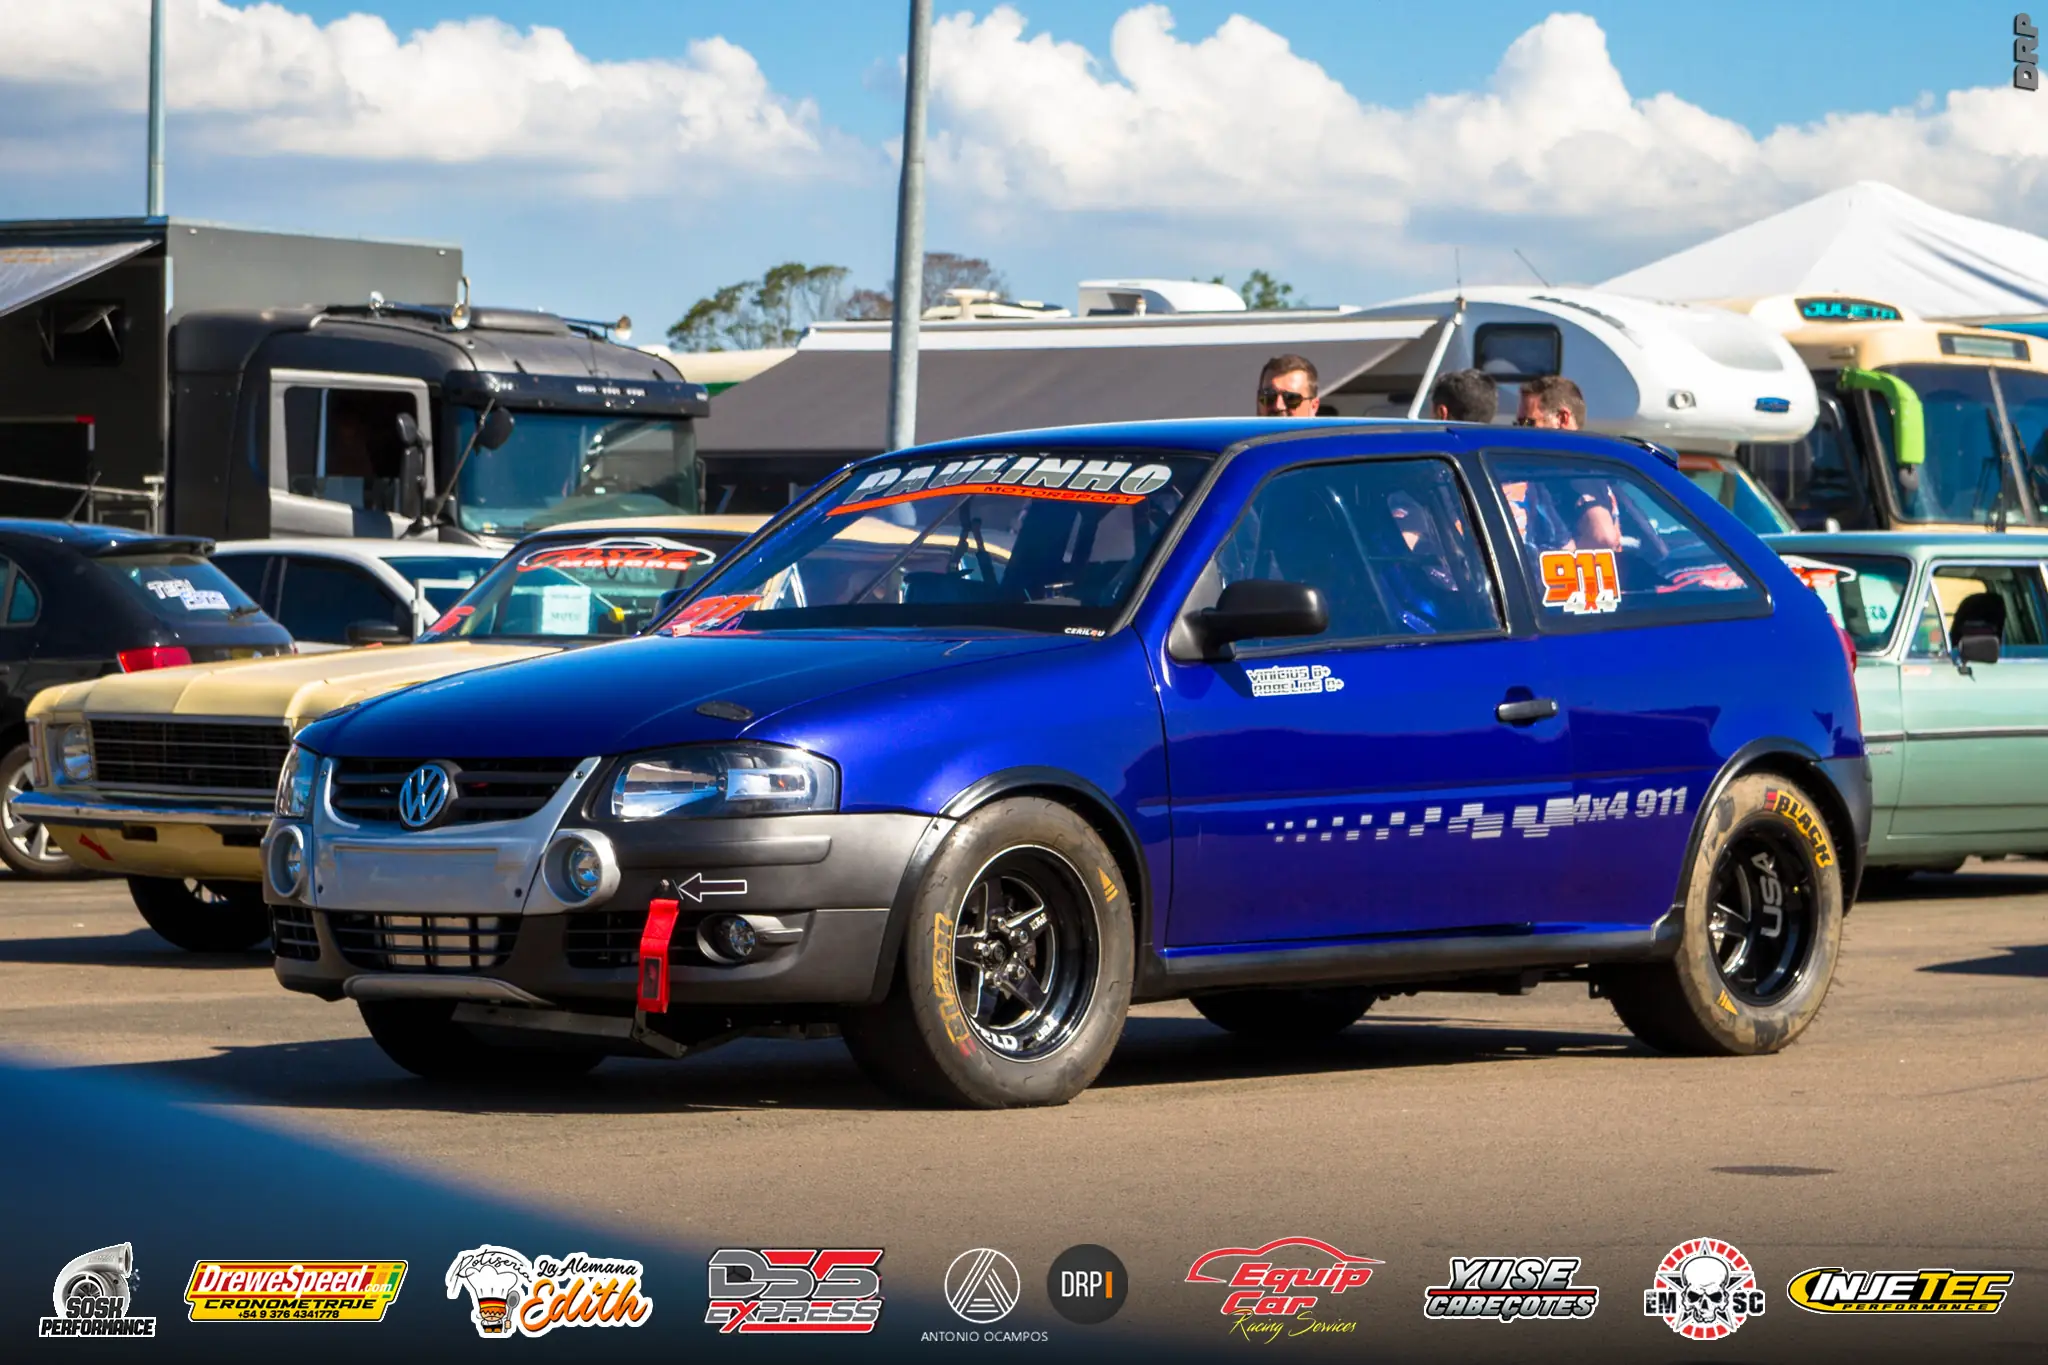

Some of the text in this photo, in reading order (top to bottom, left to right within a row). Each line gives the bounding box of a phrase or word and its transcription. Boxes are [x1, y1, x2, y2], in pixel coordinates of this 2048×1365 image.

[842, 456, 1173, 505] PAULINHO
[983, 486, 1134, 504] MOTORSPORT
[1540, 549, 1621, 606] 911
[1573, 785, 1688, 823] 4x4 911
[1776, 792, 1833, 868] BLACK
[1751, 851, 1783, 938] USA
